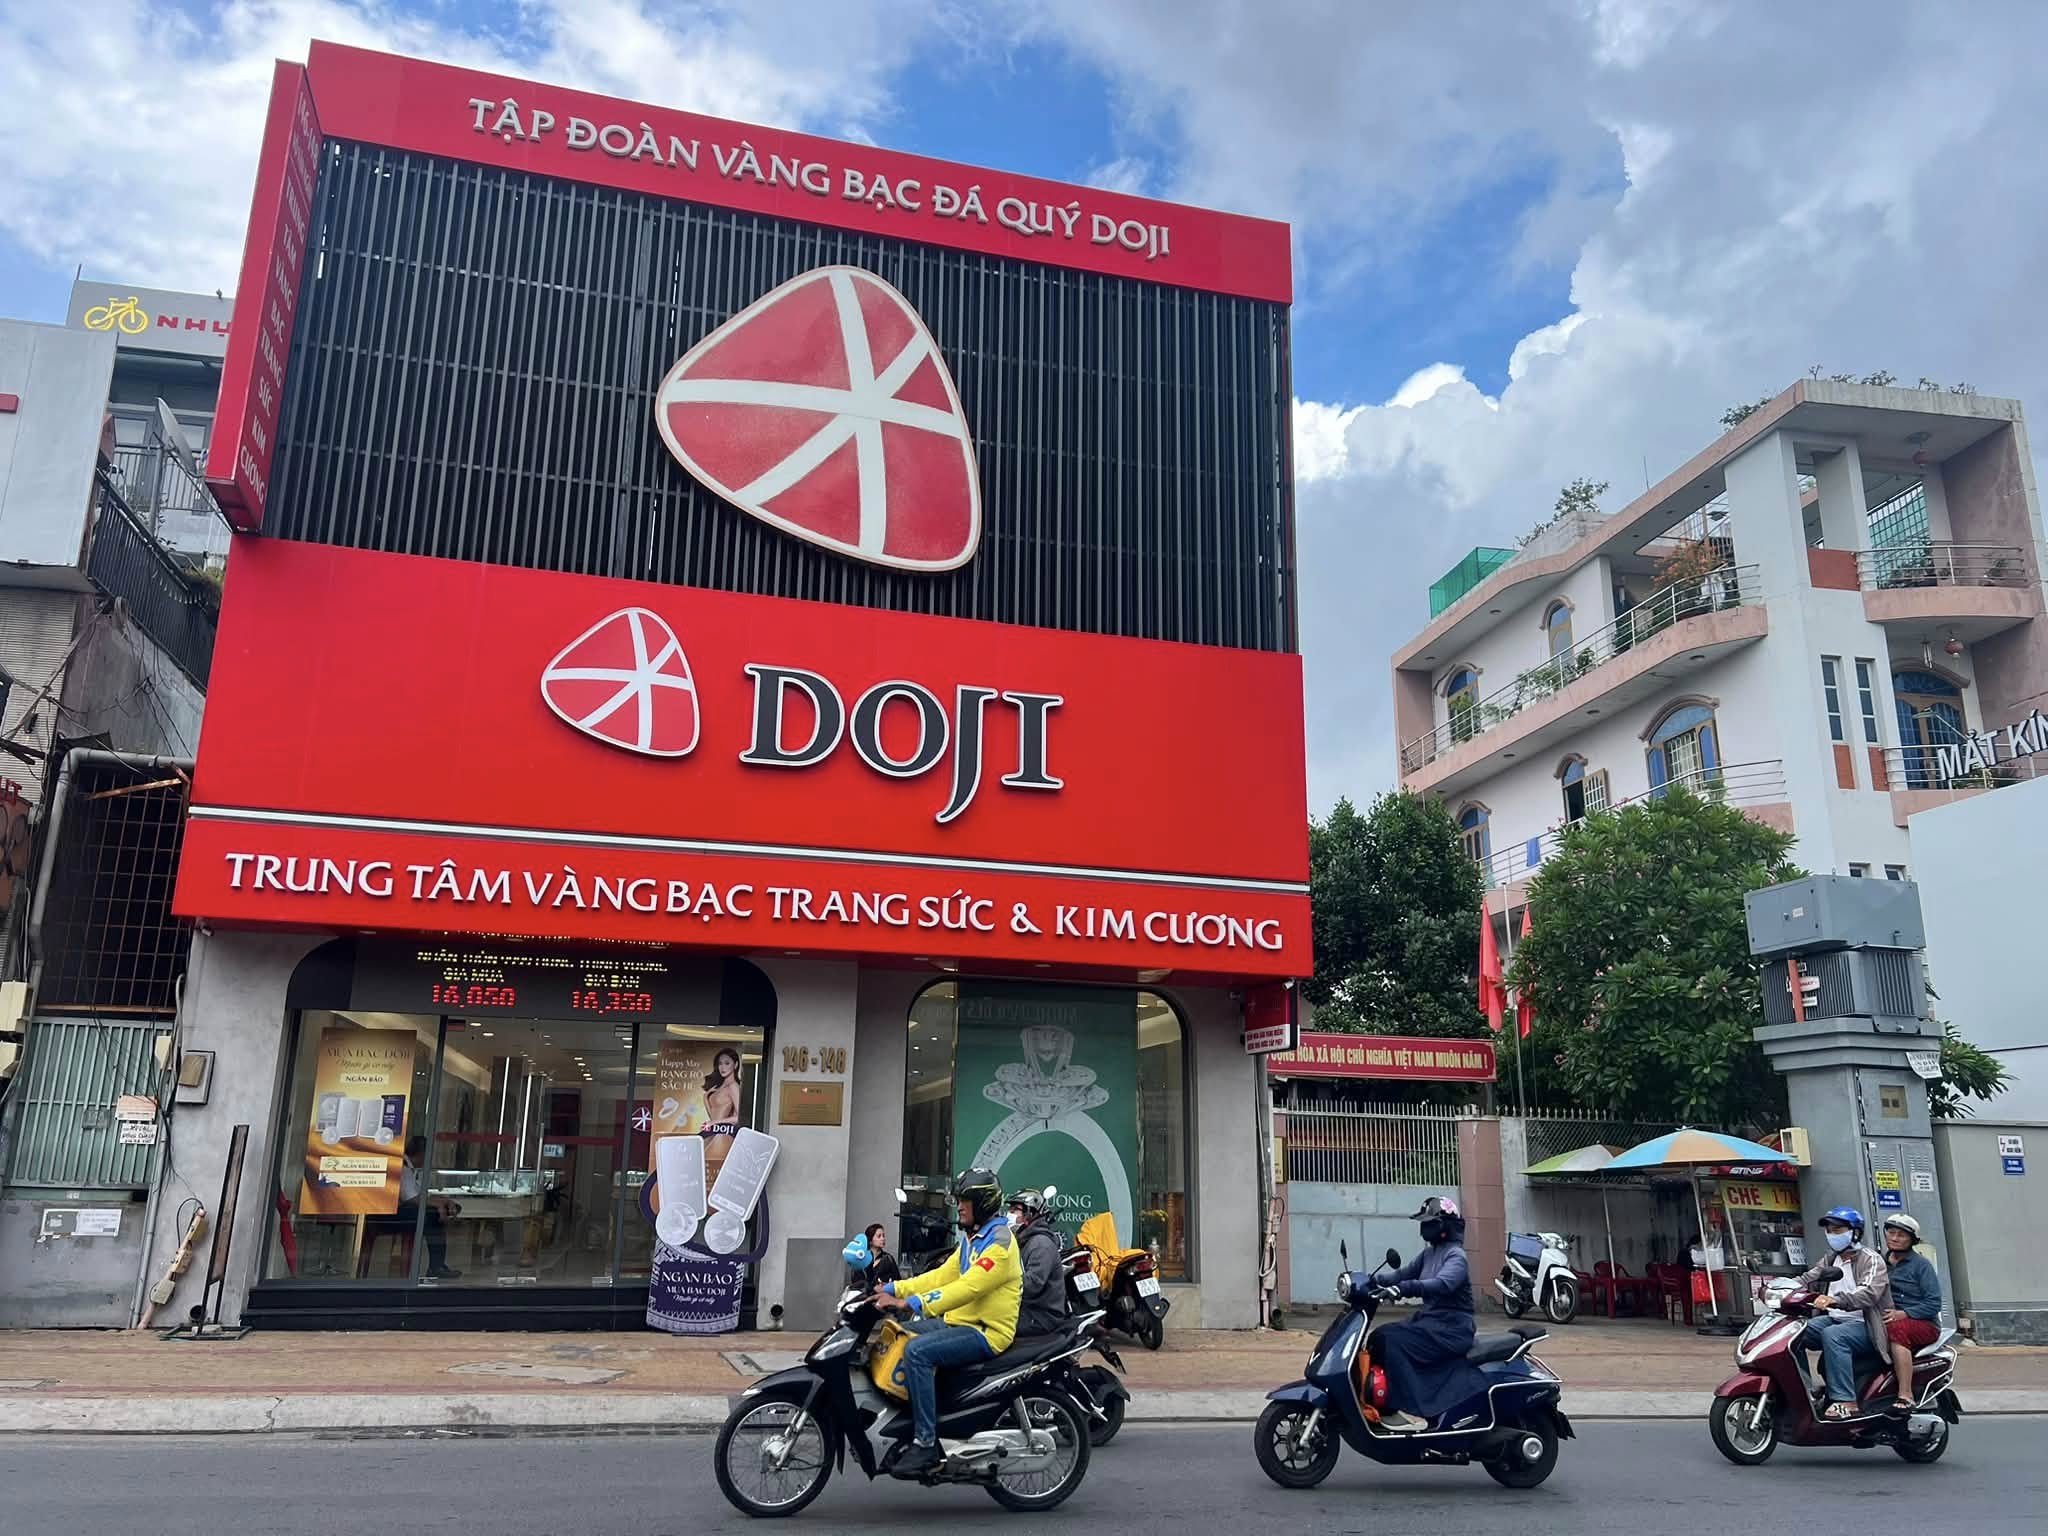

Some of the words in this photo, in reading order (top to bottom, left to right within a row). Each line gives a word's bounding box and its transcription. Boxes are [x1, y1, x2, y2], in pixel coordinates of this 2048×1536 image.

[468, 97, 555, 144] TẬP
[566, 116, 701, 170] ĐOÀN
[711, 140, 831, 196] VÀNG
[842, 168, 921, 212] BẠC
[931, 184, 988, 224] ĐÁ
[997, 200, 1082, 238] QUÝ
[1090, 214, 1171, 260] DOJI
[738, 662, 1065, 824] DOJI
[225, 852, 394, 897] TRUNG
[406, 858, 512, 904] TÂM
[522, 864, 657, 912] VÀNG
[665, 881, 754, 922] BẠC
[766, 886, 909, 928] TRANG
[917, 889, 995, 931] SỨC
[1009, 902, 1042, 935] &
[1055, 904, 1137, 940] KIM
[1143, 911, 1283, 951] CƯƠNG
[782, 1046, 808, 1072] 146
[819, 1046, 847, 1074] 148
[1331, 1044, 1345, 1067] HỘI
[1394, 1047, 1412, 1070] VIỆT
[1414, 1050, 1434, 1068] NAM
[712, 1124, 735, 1136] DOJI
